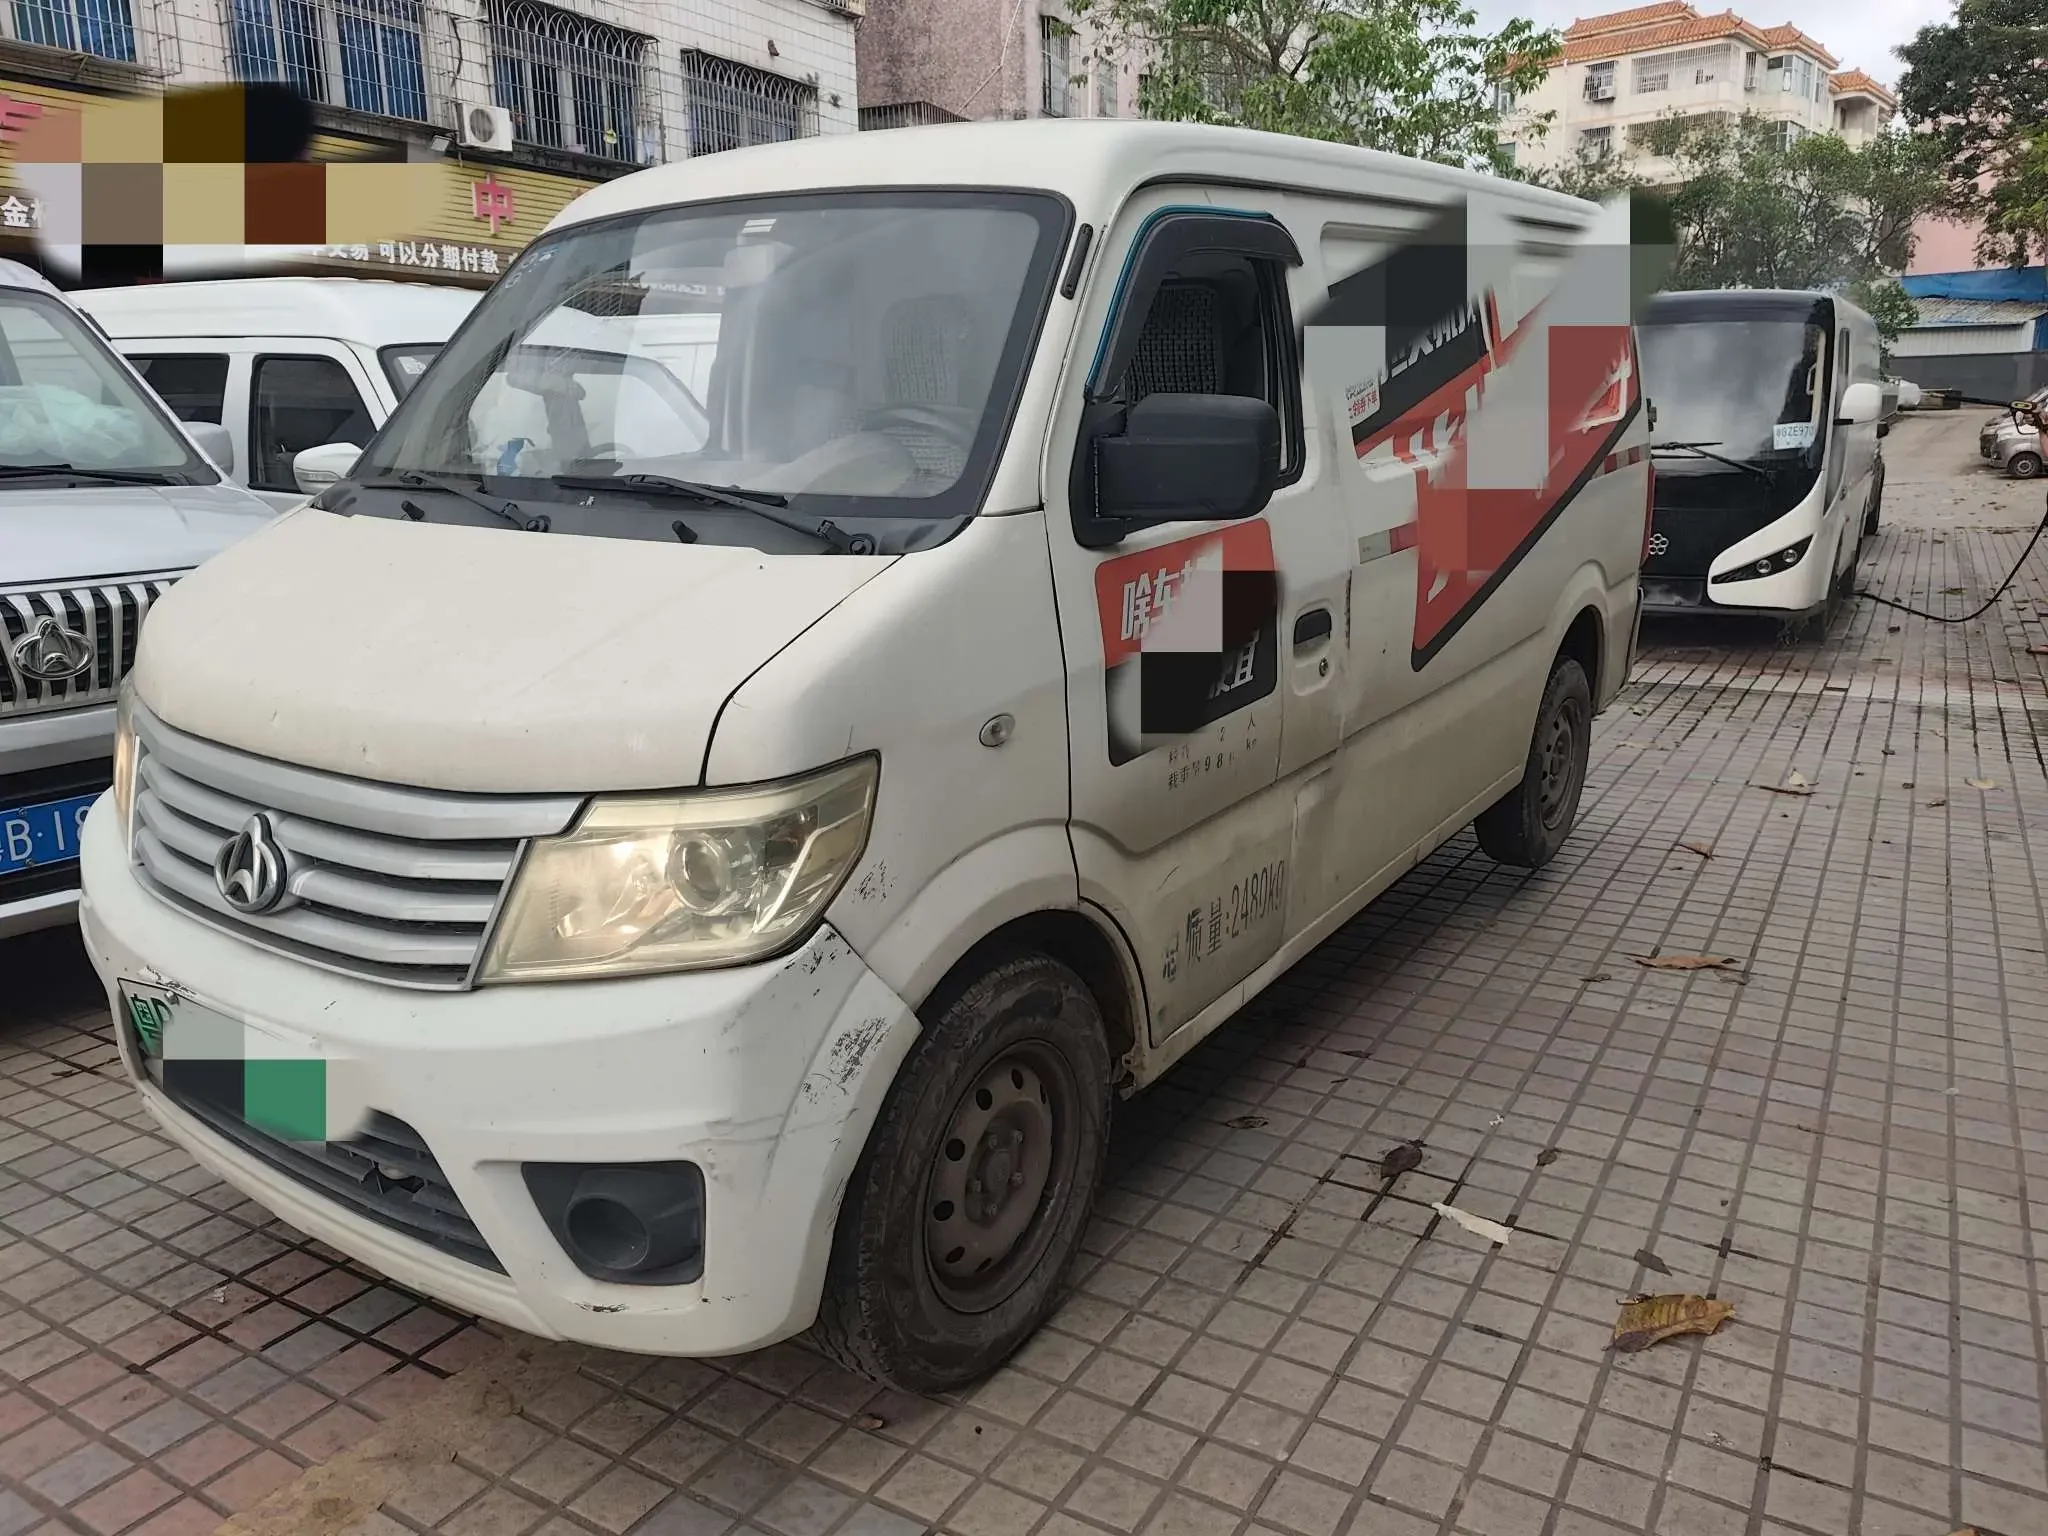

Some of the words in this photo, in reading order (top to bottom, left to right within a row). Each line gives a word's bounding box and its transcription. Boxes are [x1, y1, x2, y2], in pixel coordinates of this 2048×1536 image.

[471, 172, 513, 235] 中
[379, 240, 500, 274] 可以分期付款
[1247, 711, 1257, 731] 人
[0, 805, 91, 861] B·1
